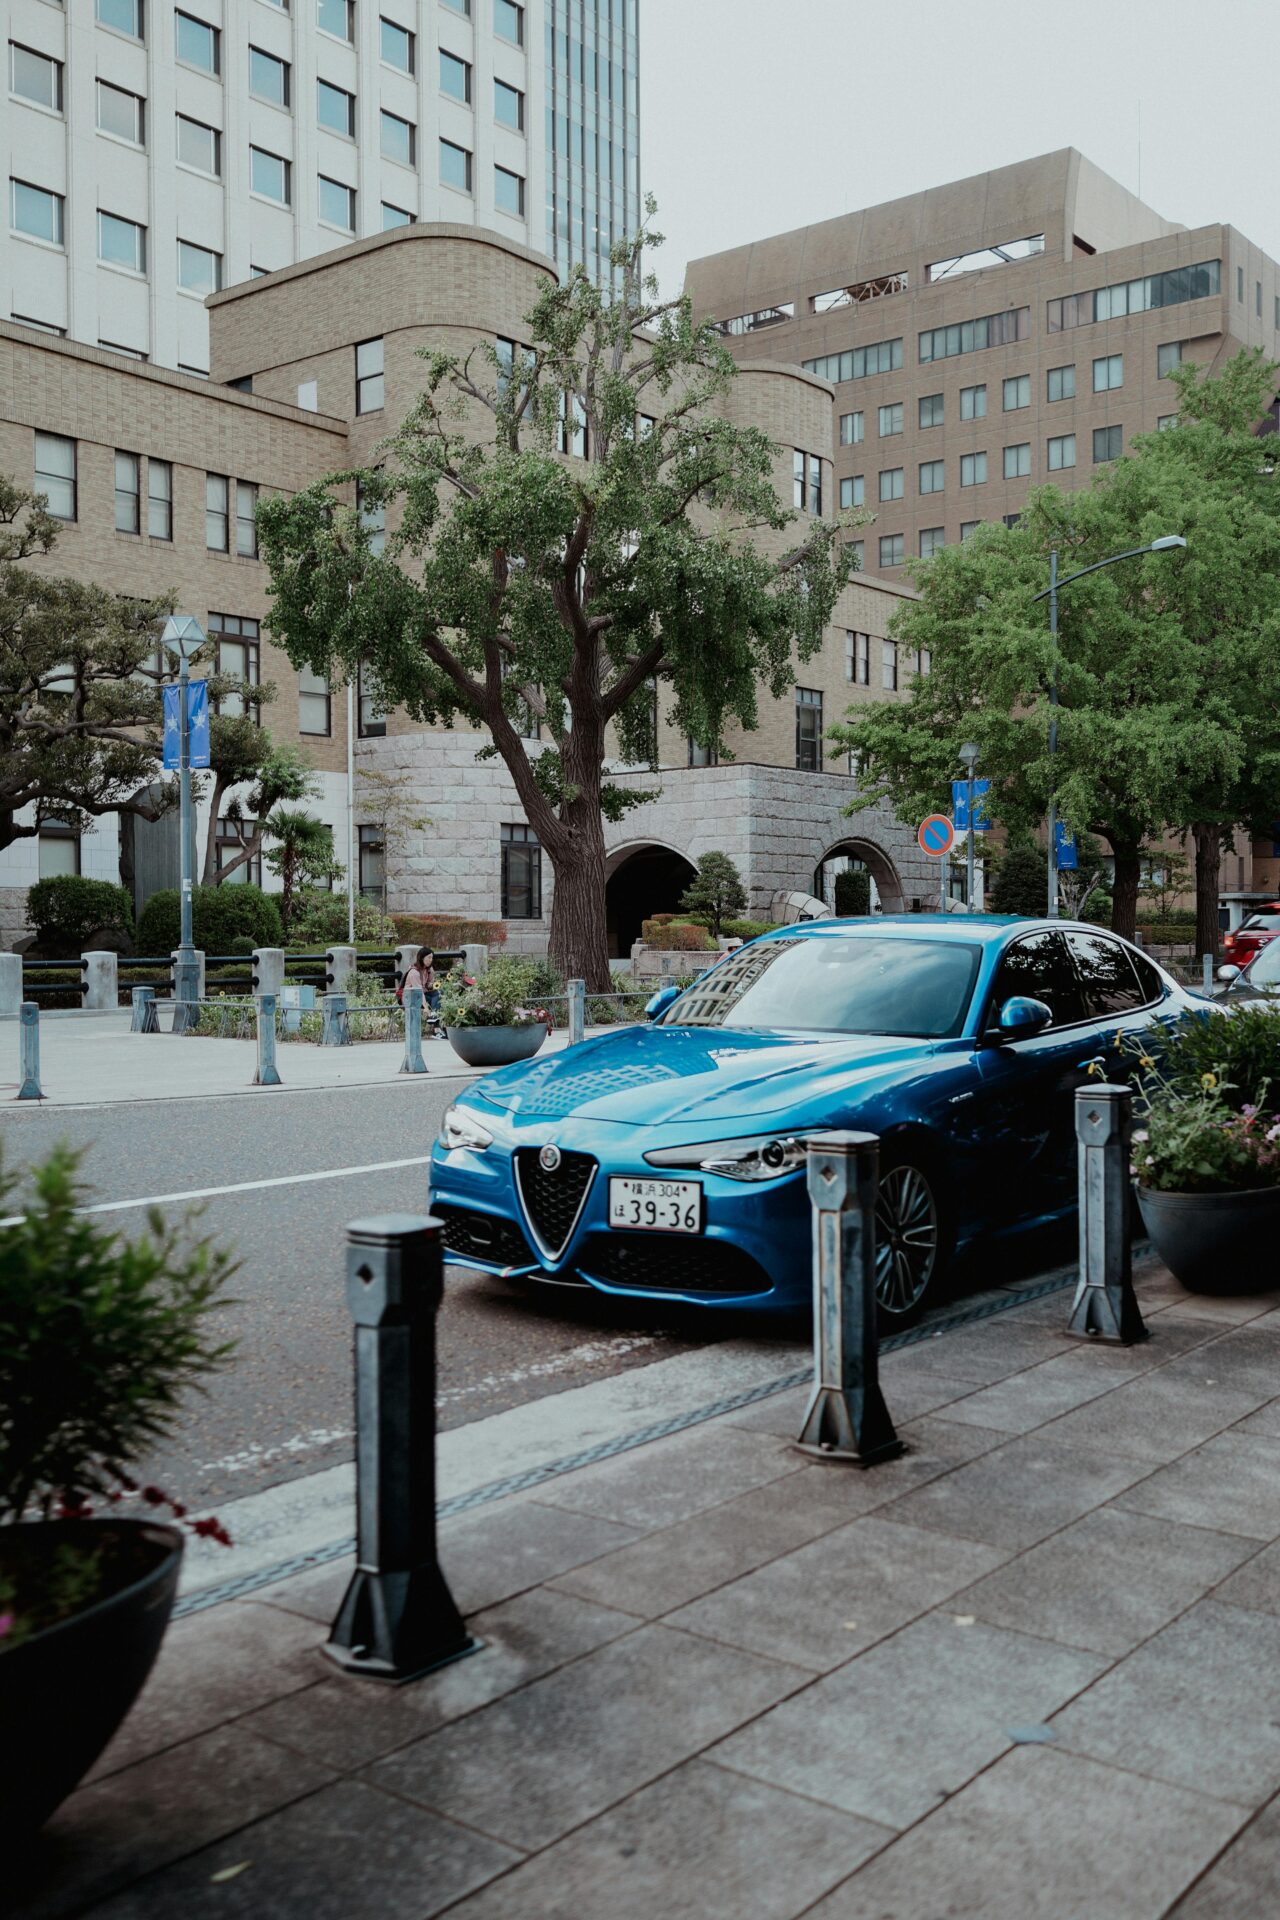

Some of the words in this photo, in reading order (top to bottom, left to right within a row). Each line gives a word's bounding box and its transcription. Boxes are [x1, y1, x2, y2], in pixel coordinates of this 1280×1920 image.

[632, 1183, 656, 1196] 横浜
[659, 1184, 680, 1197] 304
[630, 1200, 696, 1228] 39-36
